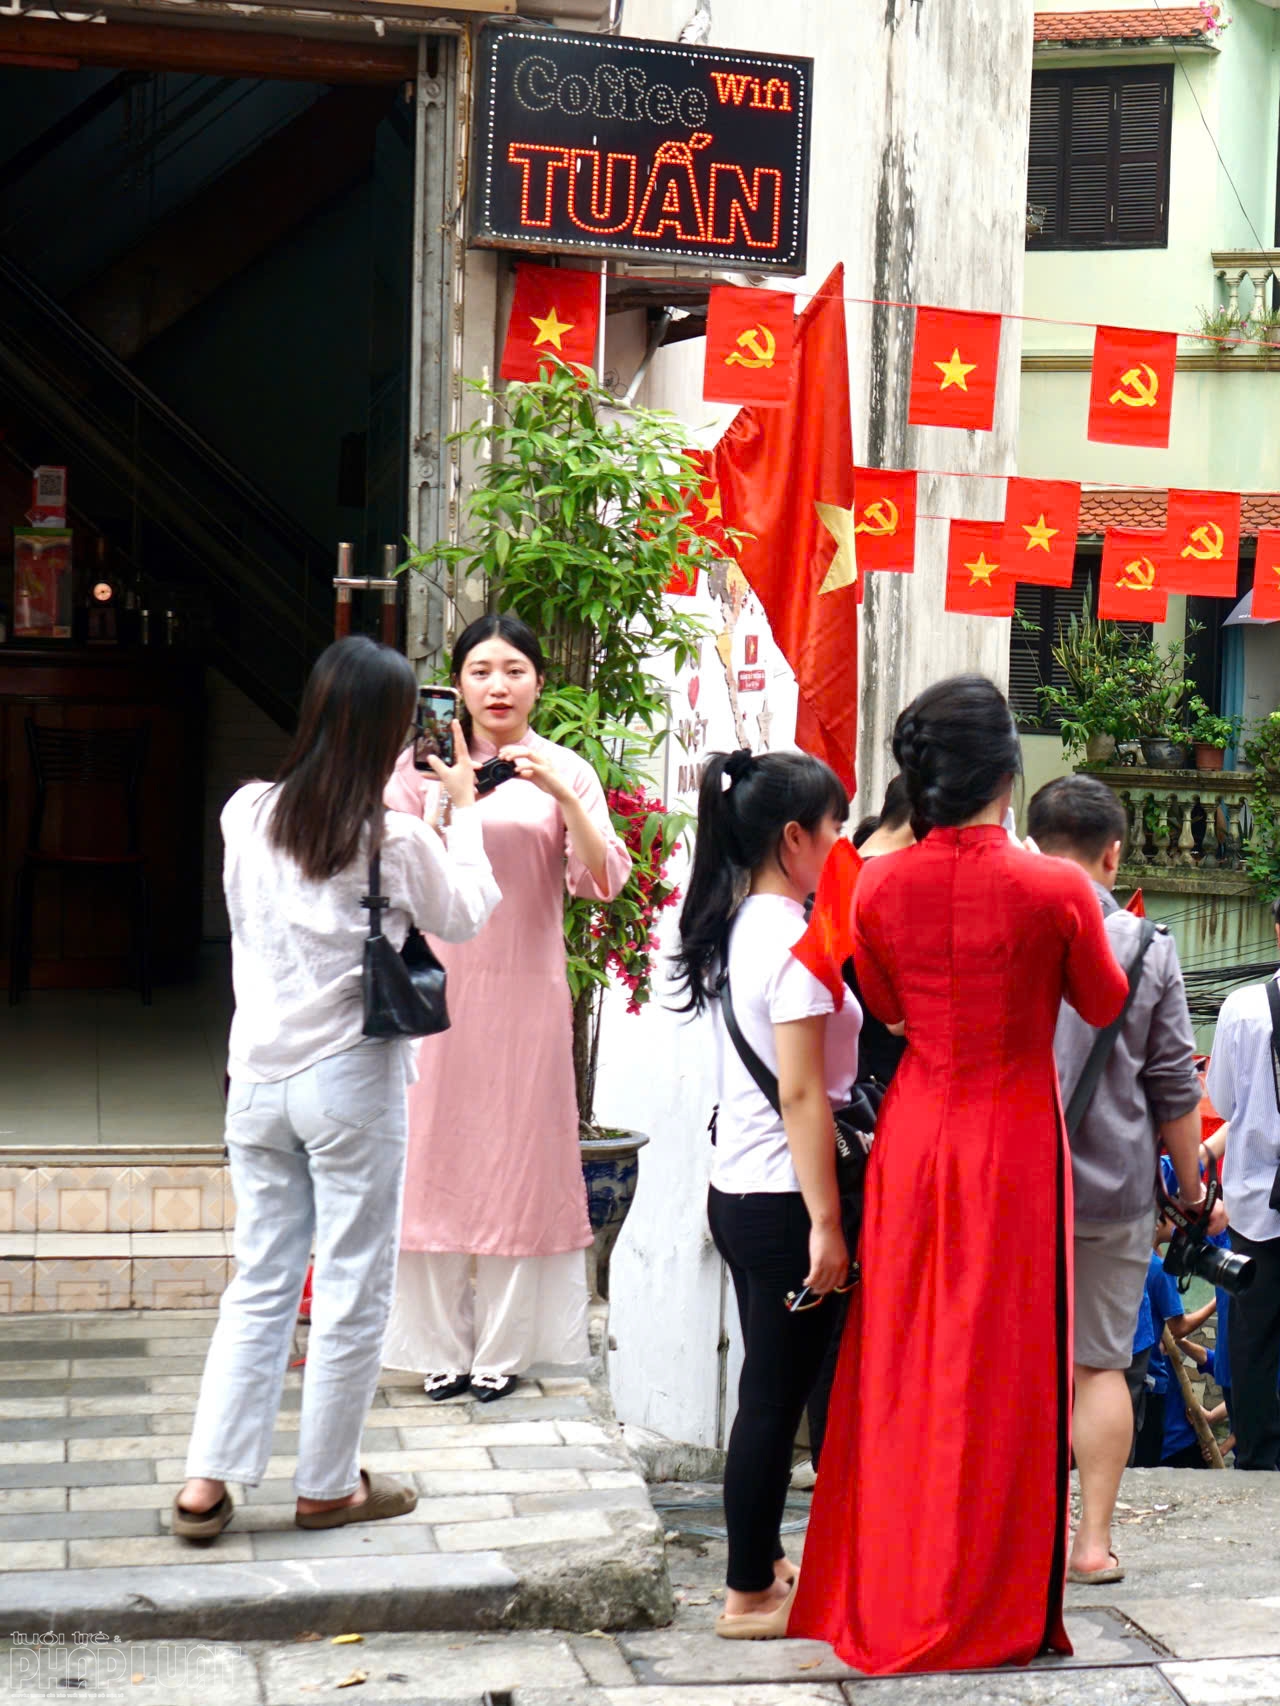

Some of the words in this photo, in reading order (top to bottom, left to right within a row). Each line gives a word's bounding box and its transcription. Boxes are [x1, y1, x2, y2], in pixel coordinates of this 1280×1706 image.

[514, 55, 708, 128] Coffee
[711, 71, 792, 112] Wifi
[508, 132, 782, 248] TUẤN
